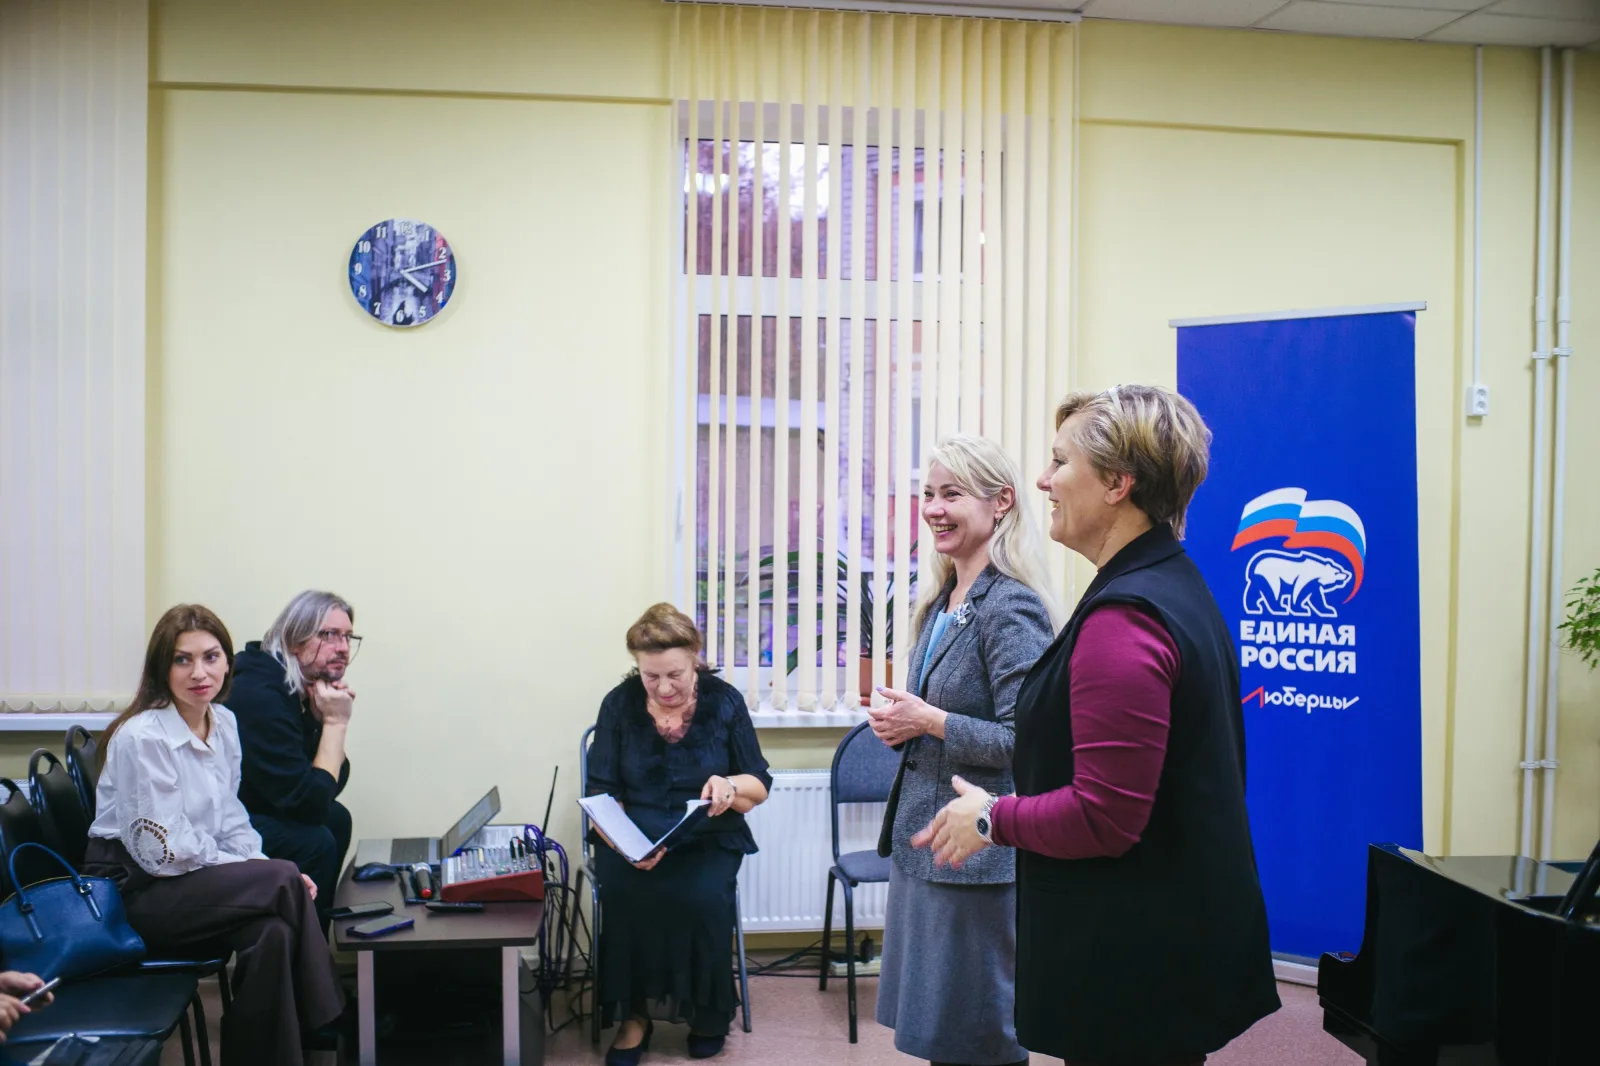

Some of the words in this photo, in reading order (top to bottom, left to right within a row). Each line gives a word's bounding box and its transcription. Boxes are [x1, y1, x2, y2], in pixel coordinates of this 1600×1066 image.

[376, 226, 386, 239] 11
[425, 229, 430, 241] 1
[358, 241, 371, 253] 10
[439, 247, 446, 259] 2
[354, 263, 362, 275] 9
[443, 269, 451, 281] 3
[359, 285, 366, 298] 8
[436, 292, 443, 303] 4
[374, 302, 381, 315] 7
[420, 306, 426, 317] 5
[396, 310, 404, 322] 6
[1240, 620, 1355, 646] ЕДИНАЯ
[1241, 646, 1356, 674] РОССИЯ
[1241, 686, 1360, 714] Люберцы
